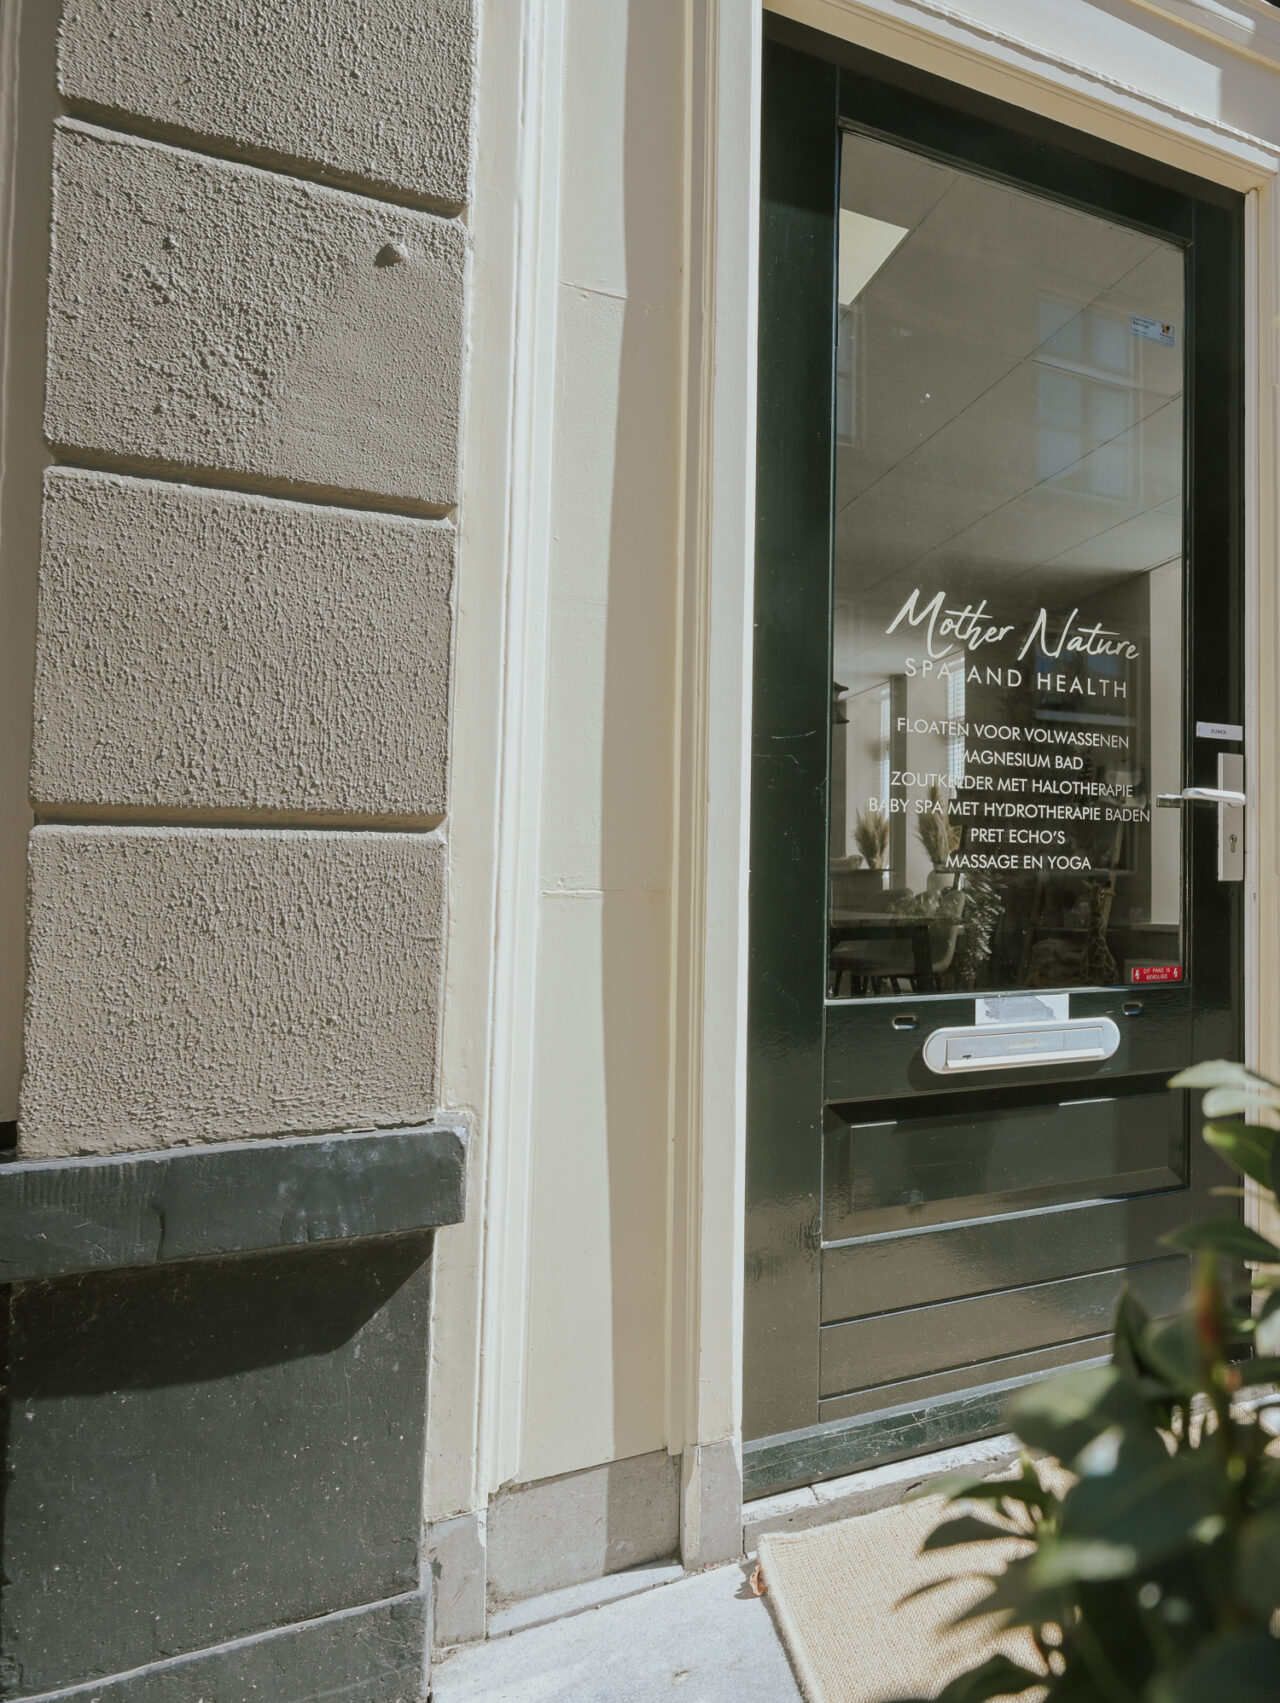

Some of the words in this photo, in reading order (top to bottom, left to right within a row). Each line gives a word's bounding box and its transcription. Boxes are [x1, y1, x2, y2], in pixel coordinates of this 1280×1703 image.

[886, 588, 1015, 659] Mother
[1017, 607, 1140, 661] Nature
[904, 657, 952, 679] SPA
[967, 665, 1022, 687] AND
[1037, 672, 1127, 698] HEALTH
[897, 717, 969, 737] FLOATEN
[974, 724, 1021, 741] VOOR
[1024, 727, 1129, 749] VOLWASSENEN
[960, 749, 1051, 769] MAGNESIUM
[1055, 756, 1083, 770] BAD
[890, 771, 994, 791] ZOUTKELDER
[997, 778, 1027, 792] MET
[1032, 780, 1134, 798] HALOTHERAPIE
[868, 797, 910, 813] BABY
[915, 800, 943, 815] SPA
[947, 802, 980, 817] MET
[984, 803, 1101, 821] HYDROTHERAPIE
[1105, 808, 1150, 823] BADEN
[970, 828, 1004, 843] PRET
[1009, 829, 1066, 845] ECHO'S
[945, 854, 1018, 870] MASSAGE
[1023, 855, 1043, 870] EN
[1047, 855, 1091, 871] YOGA
